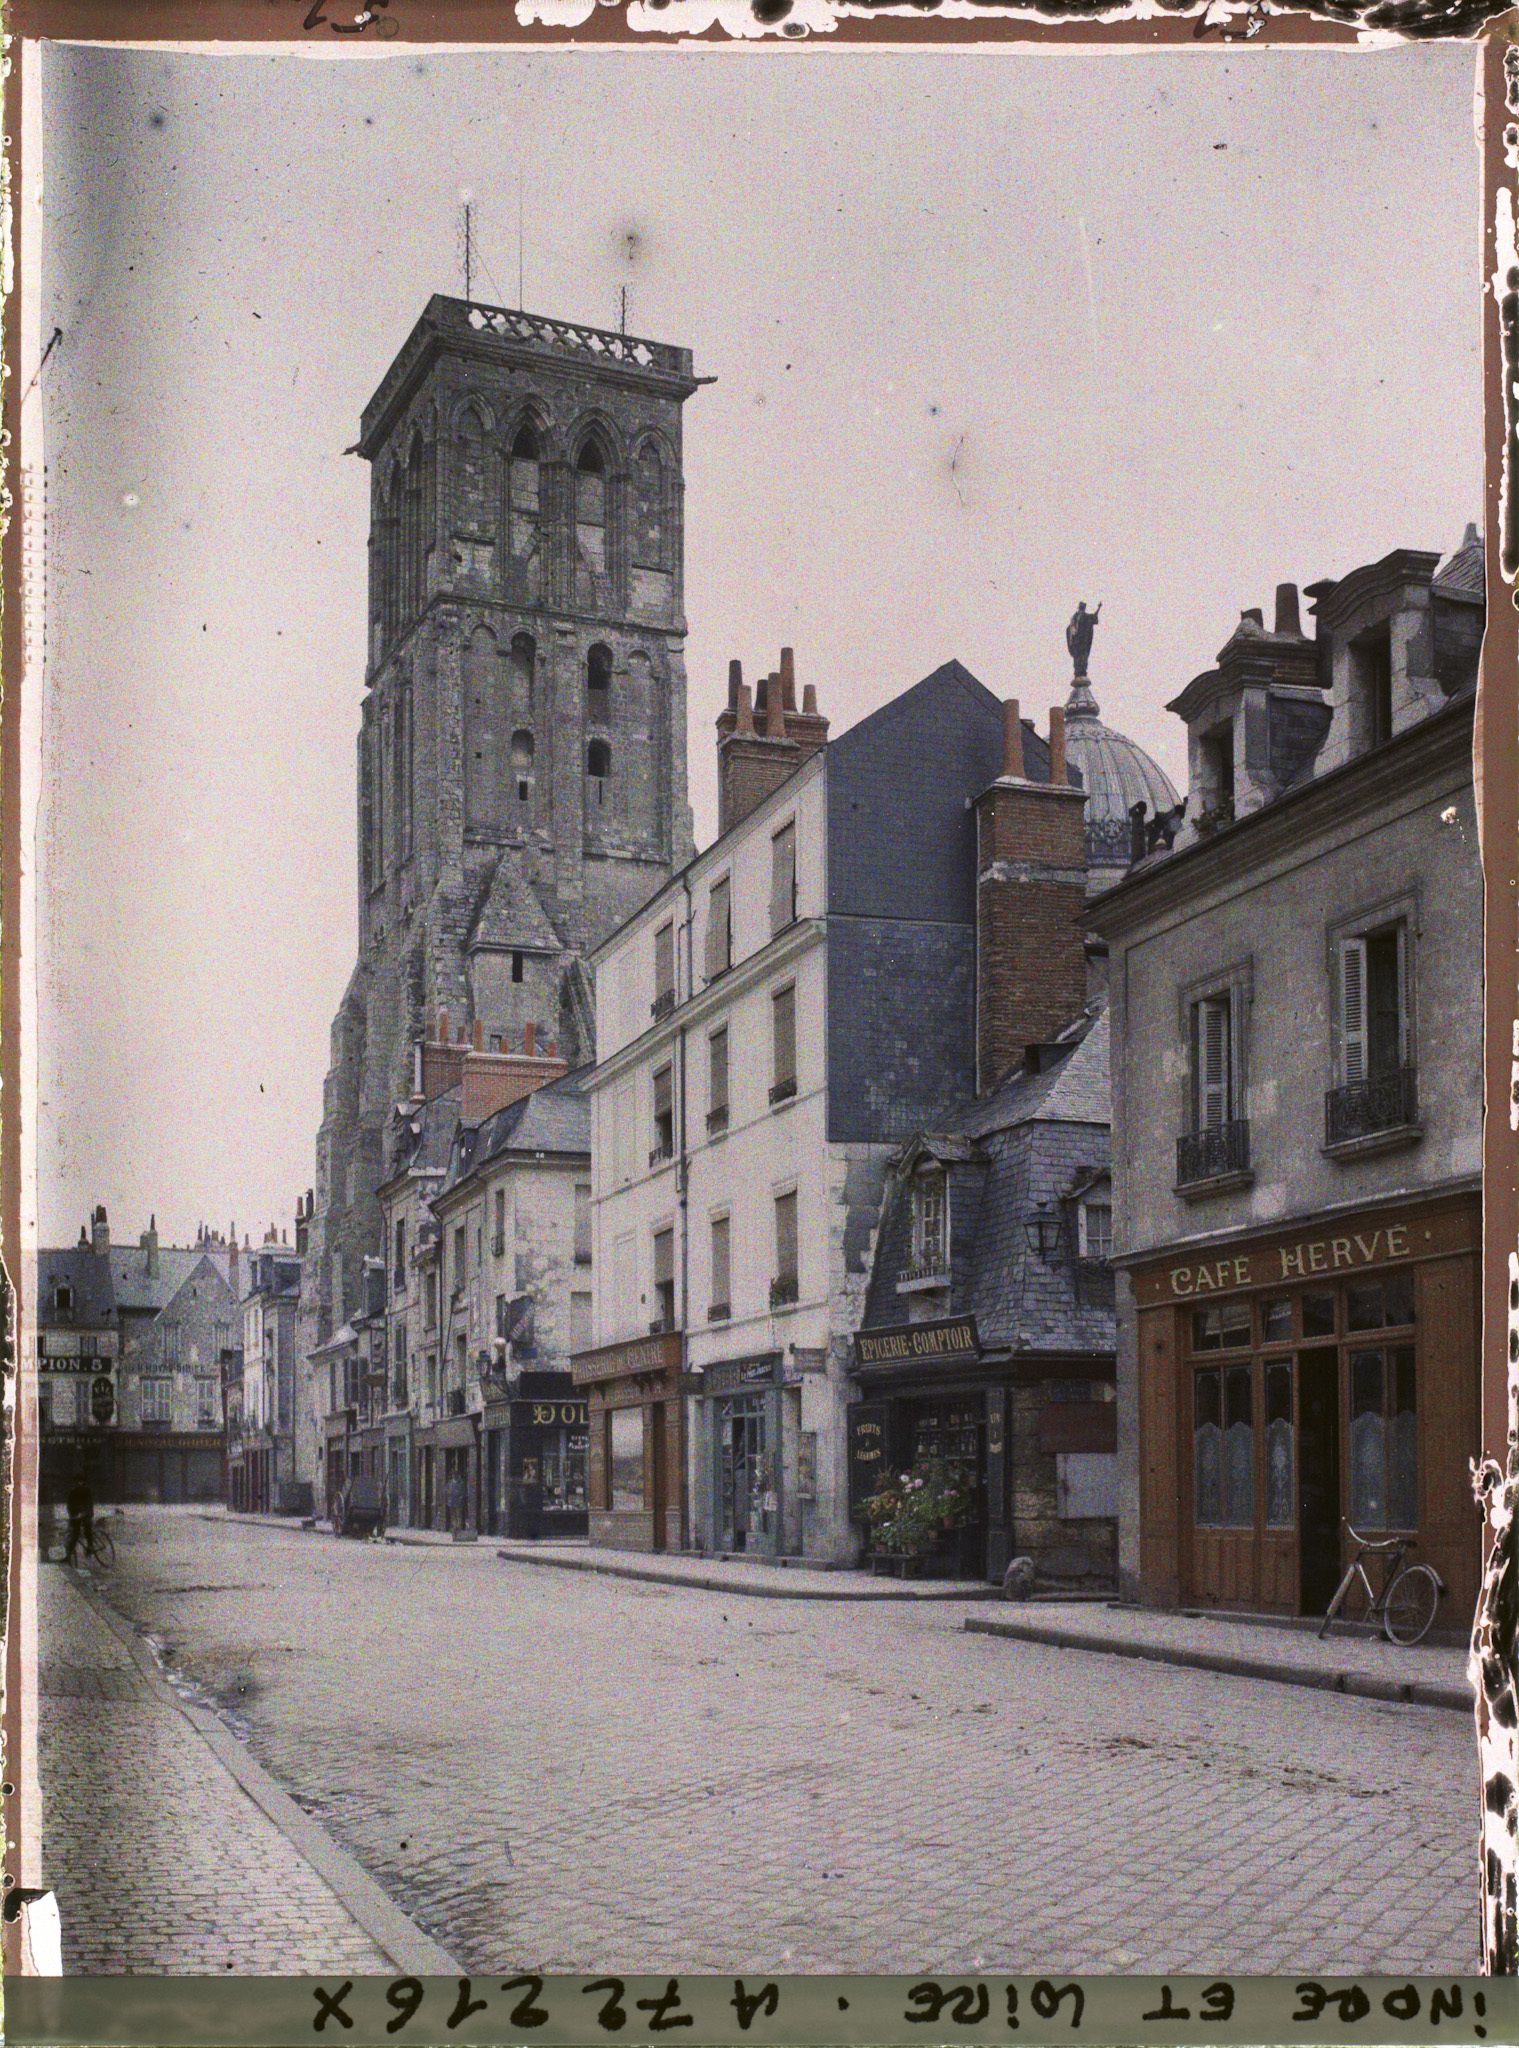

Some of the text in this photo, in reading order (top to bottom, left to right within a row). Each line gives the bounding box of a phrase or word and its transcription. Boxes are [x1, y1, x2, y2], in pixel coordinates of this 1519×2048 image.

[1169, 1224, 1411, 1297] CAFÉ HERVÉ
[1142, 1982, 1236, 2022] ET
